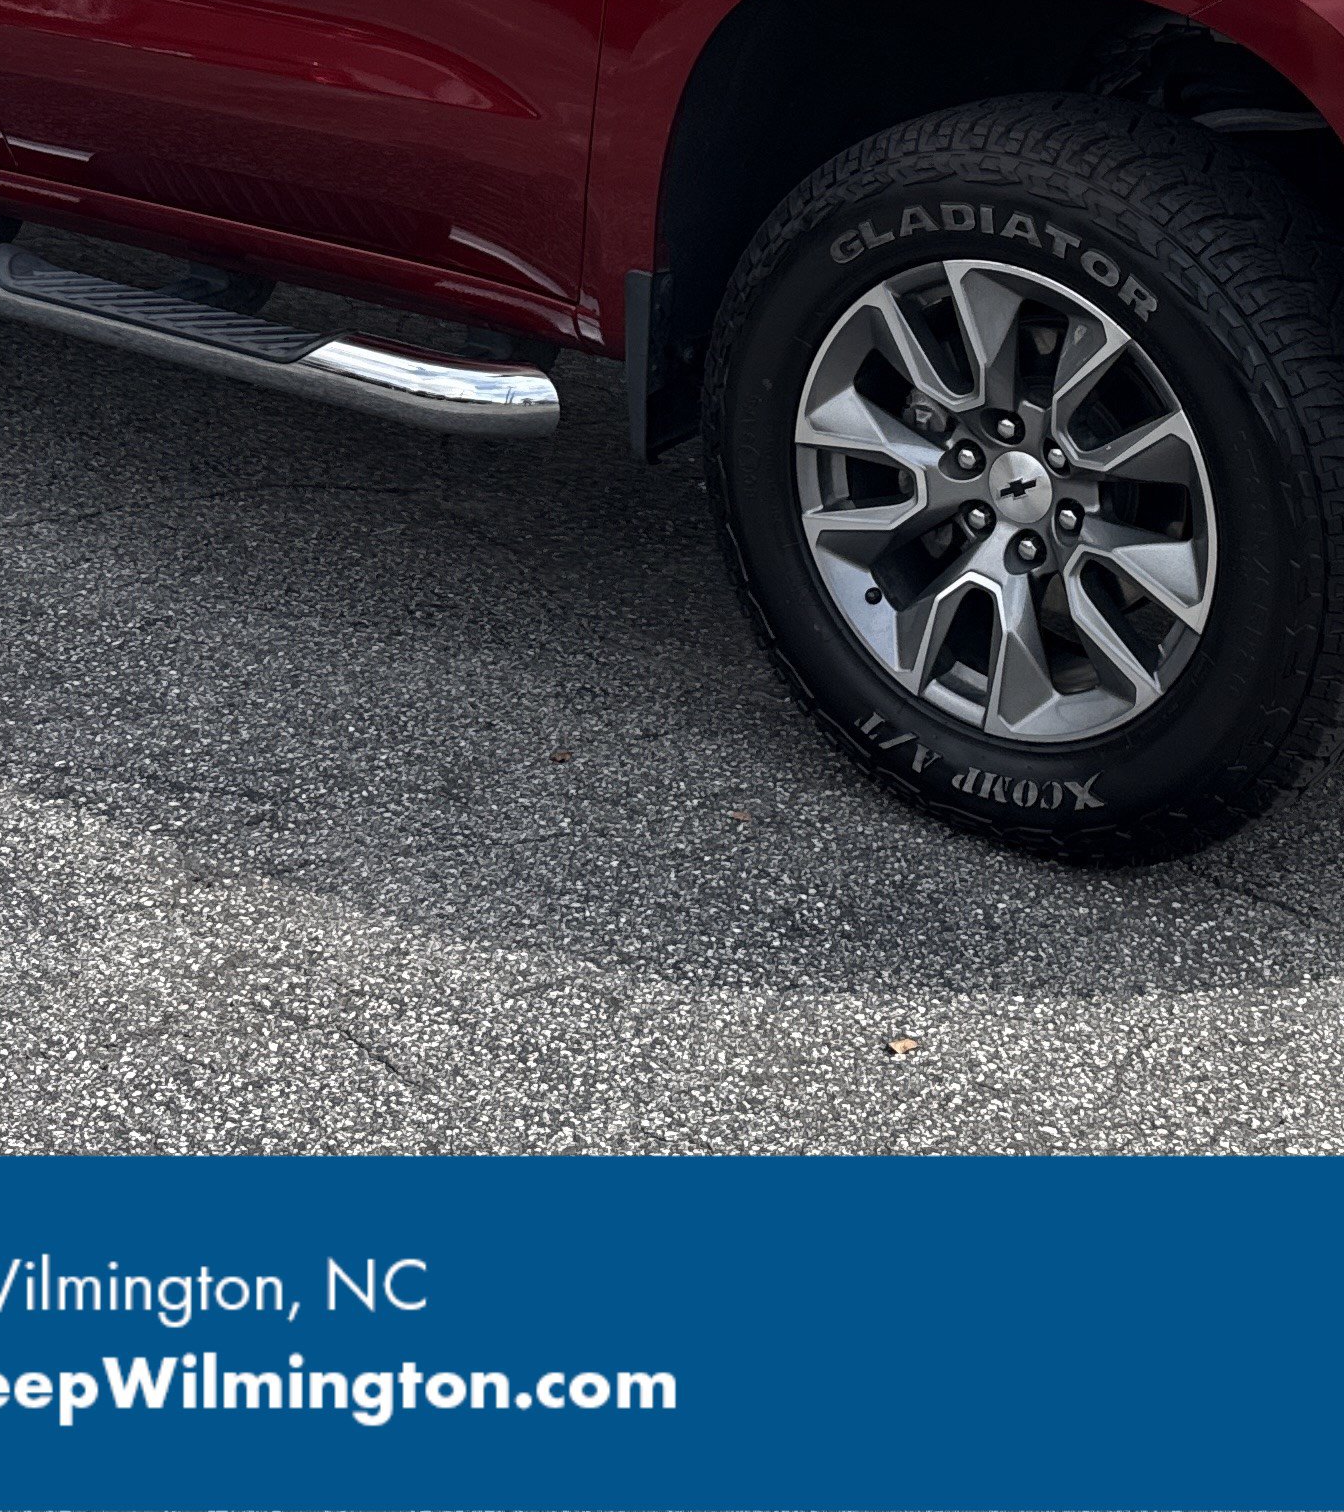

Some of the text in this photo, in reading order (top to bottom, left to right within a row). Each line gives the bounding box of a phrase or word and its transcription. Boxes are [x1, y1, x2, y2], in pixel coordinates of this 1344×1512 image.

[830, 201, 1158, 323] GLADIATOR
[854, 712, 1107, 811] XCOMP A/T
